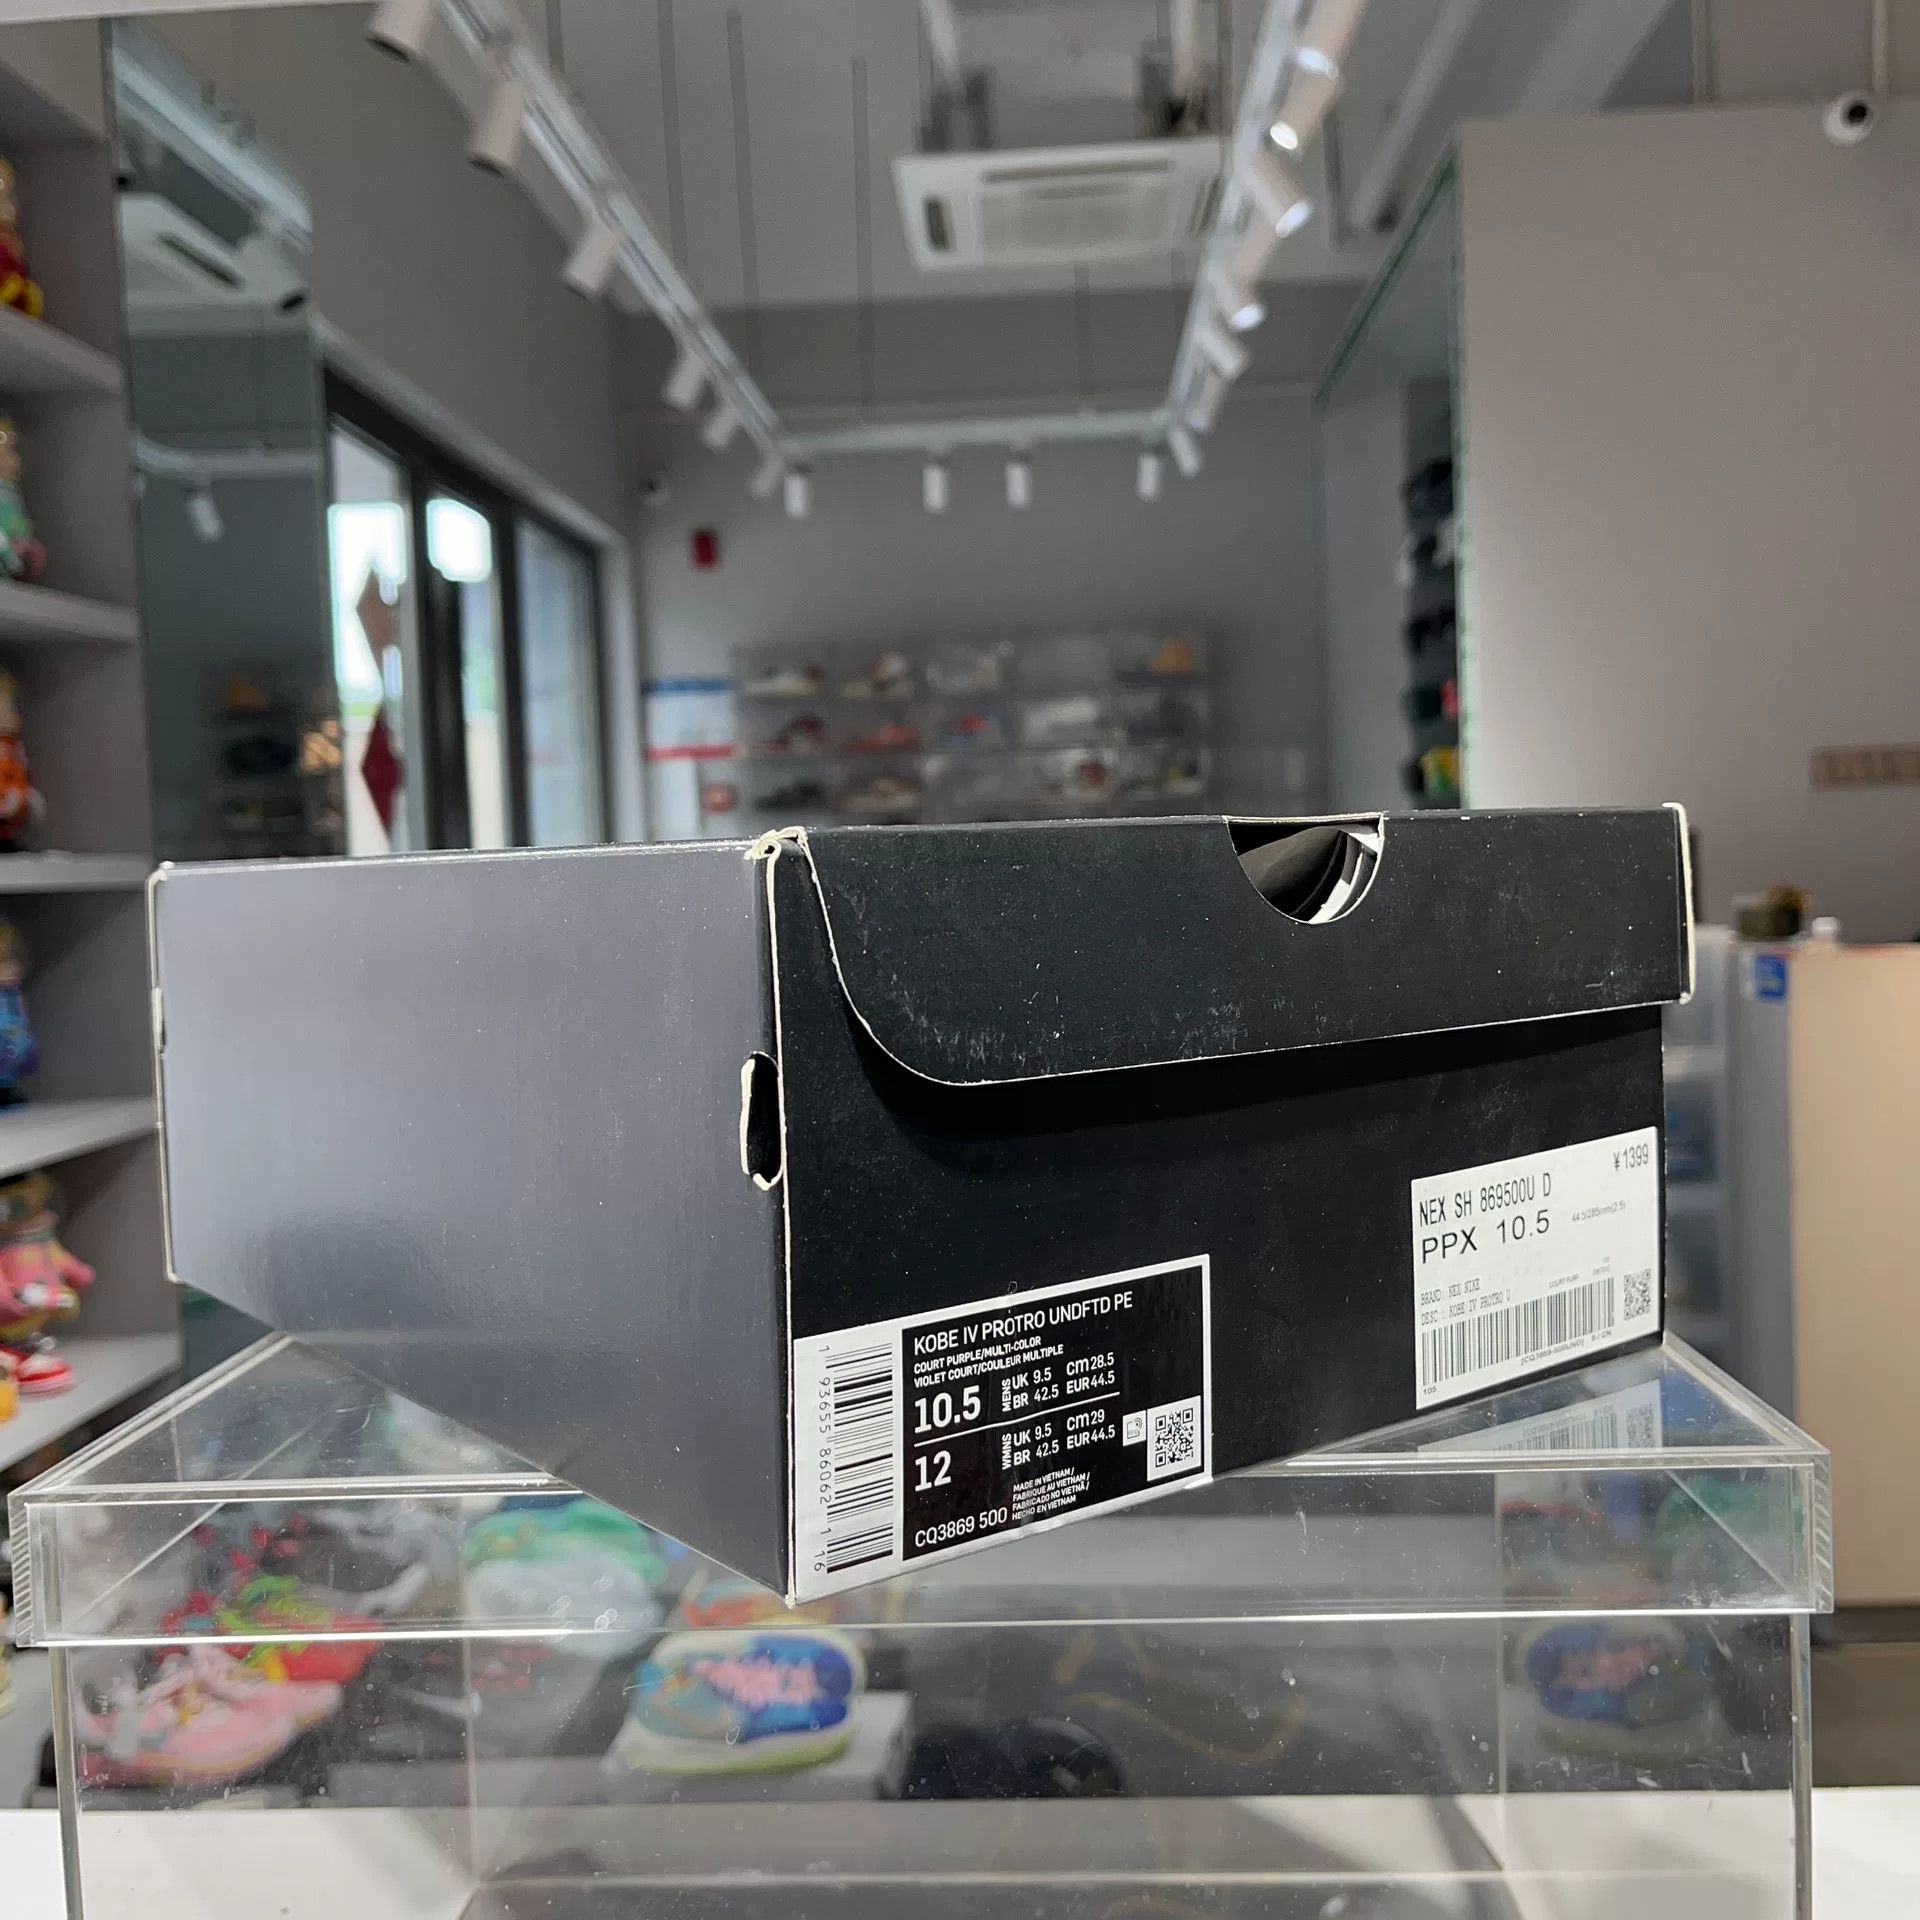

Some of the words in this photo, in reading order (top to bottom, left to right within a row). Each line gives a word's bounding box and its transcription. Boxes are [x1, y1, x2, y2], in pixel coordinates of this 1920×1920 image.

[1613, 1143, 1649, 1172] ¥1399
[1419, 1196, 1447, 1227] NEX
[1454, 1190, 1472, 1218] SH
[1480, 1175, 1535, 1212] 869500U
[1543, 1172, 1551, 1197] D
[1422, 1226, 1478, 1264] PPX
[1496, 1209, 1550, 1244] 10.5
[914, 1329, 959, 1355] KOBE
[963, 1324, 979, 1344] IV
[982, 1310, 1046, 1340] PROTRO
[1049, 1296, 1110, 1325] UNDFTD
[1114, 1291, 1133, 1310] PE
[914, 1357, 945, 1374] COURT
[946, 1336, 1041, 1366] PURPLE/MULTI-COLOR
[914, 1373, 946, 1388] VIOLET
[948, 1352, 1021, 1381] COURT/COULEUR
[1022, 1344, 1064, 1363] MULTIPLE
[1012, 1373, 1029, 1390] UK
[1033, 1367, 1052, 1384] 9.5
[1066, 1358, 1089, 1376] cm
[1090, 1352, 1115, 1370] 28.5
[819, 1377, 831, 1434] 93655
[1001, 1378, 1012, 1412] MENS
[1013, 1392, 1029, 1409] BR
[1034, 1384, 1059, 1402] 42.5
[1066, 1376, 1090, 1395] EUR
[1090, 1370, 1115, 1388] 44.5
[1423, 1387, 1437, 1396] 105
[914, 1384, 981, 1434] 10.5
[1013, 1430, 1031, 1446] UK
[1035, 1423, 1052, 1440] 9.5
[1066, 1412, 1089, 1431] cm
[1090, 1409, 1105, 1425] 29
[1001, 1433, 1012, 1470] WMNS
[1013, 1449, 1031, 1466] BR
[1035, 1440, 1060, 1458] 42.5
[1066, 1431, 1090, 1450] EUR
[1090, 1424, 1116, 1442] 44.5
[819, 1448, 832, 1505] 86062
[914, 1450, 951, 1492] 12
[1012, 1485, 1046, 1502] FABRIQUE
[1047, 1483, 1056, 1493] AU
[1056, 1474, 1086, 1488] VIETNAM
[1013, 1480, 1034, 1492] MADE
[1034, 1477, 1042, 1486] IN
[1042, 1470, 1070, 1483] VIETNAM
[1011, 1507, 1035, 1521] HECHO
[1036, 1504, 1047, 1513] EN
[1047, 1495, 1076, 1510] VIETNAM
[1012, 1494, 1050, 1511] FABRICADO
[1051, 1490, 1060, 1500] NO
[915, 1515, 975, 1547] CQ3869
[979, 1507, 1008, 1529] 500
